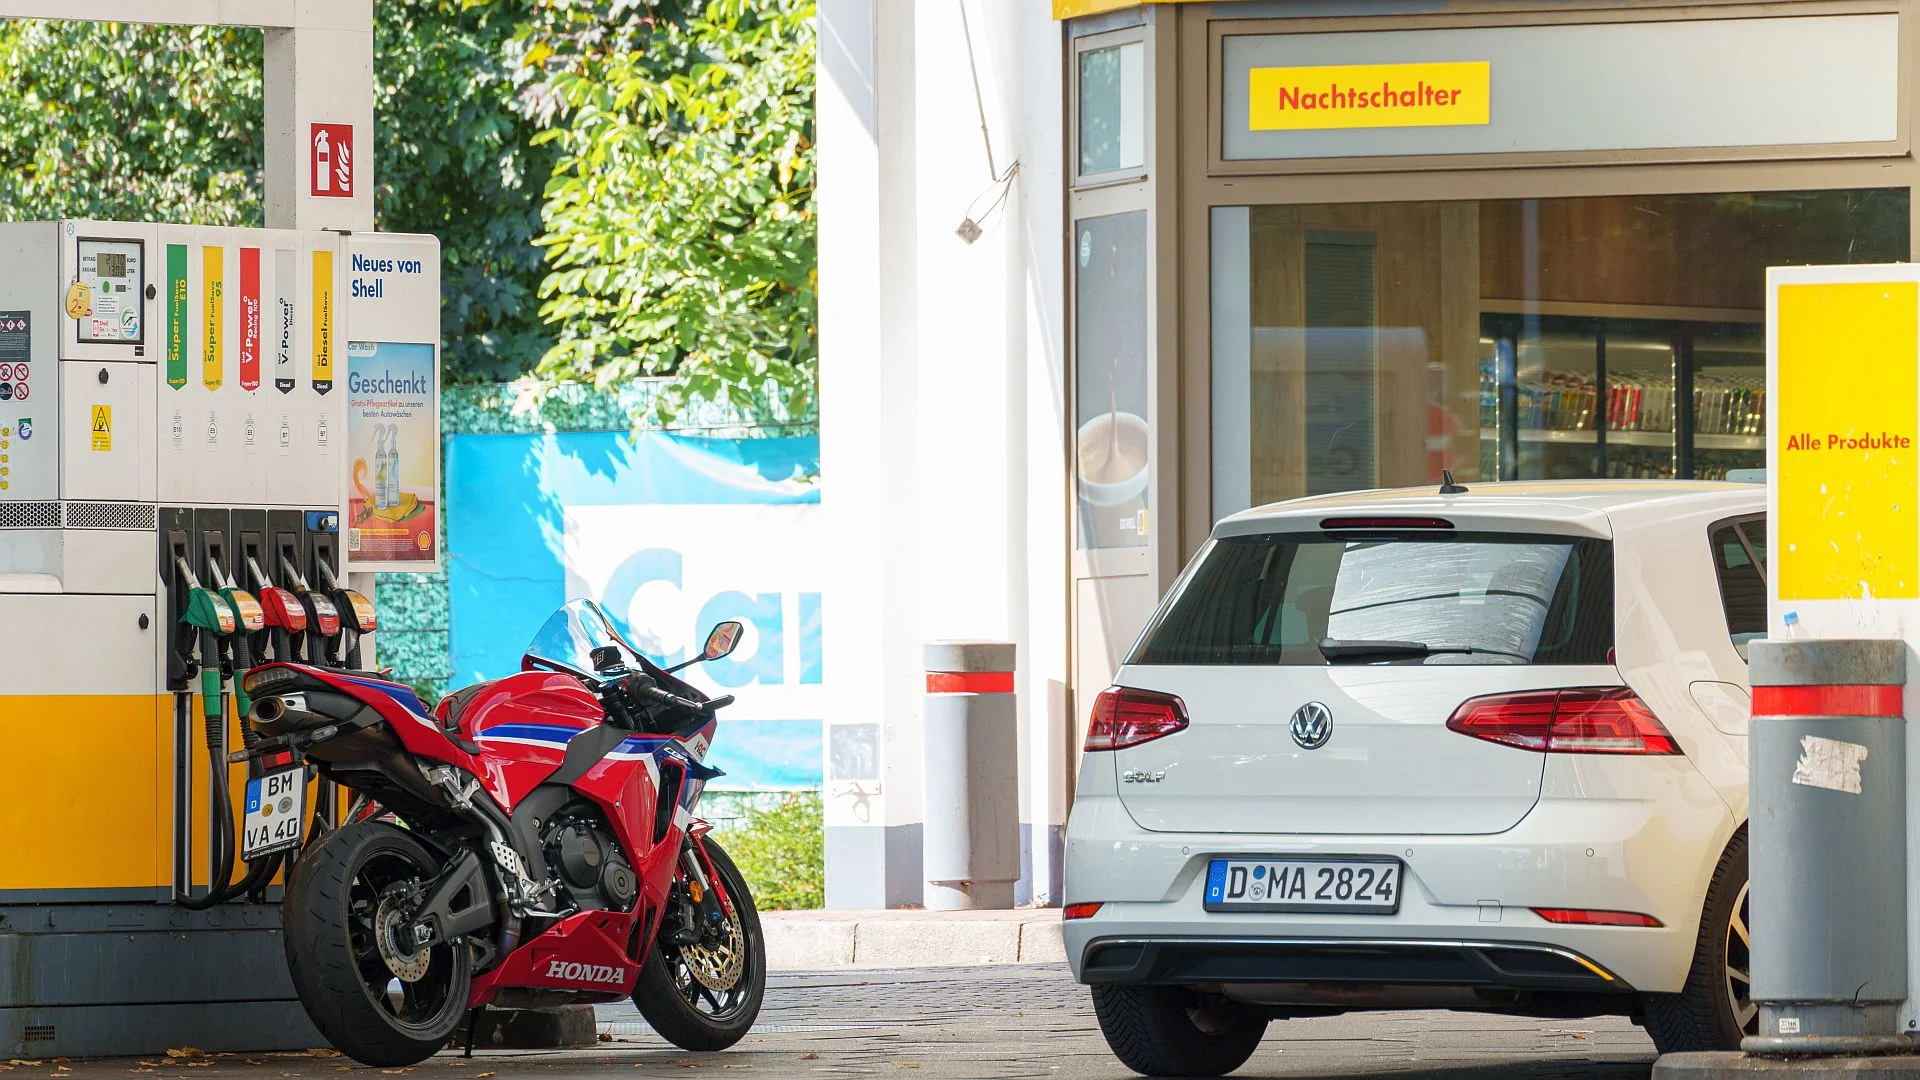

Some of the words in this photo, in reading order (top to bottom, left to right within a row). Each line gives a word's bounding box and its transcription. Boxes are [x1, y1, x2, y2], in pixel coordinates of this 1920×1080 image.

[1279, 81, 1462, 110] Nachtschalter
[352, 254, 393, 273] Neues
[397, 260, 421, 274] von
[215, 281, 222, 298] 95
[352, 278, 383, 298] Shell
[171, 318, 180, 361] Super
[208, 320, 216, 362] Super
[245, 299, 254, 364] V-Power
[281, 300, 289, 364] V-Power
[320, 327, 328, 367] Diesel
[349, 370, 427, 394] Geschenkt
[1786, 433, 1821, 451] Alle
[1827, 431, 1911, 450] Produkte
[268, 772, 293, 797] BM
[1123, 770, 1166, 784] GOLF
[251, 800, 257, 809] D
[247, 825, 270, 849] VA
[274, 817, 298, 840] 40
[1212, 887, 1219, 897] D
[1227, 866, 1248, 898] D
[1266, 866, 1306, 900] MA
[1314, 867, 1394, 901] 2824
[545, 960, 625, 984] HONDA
